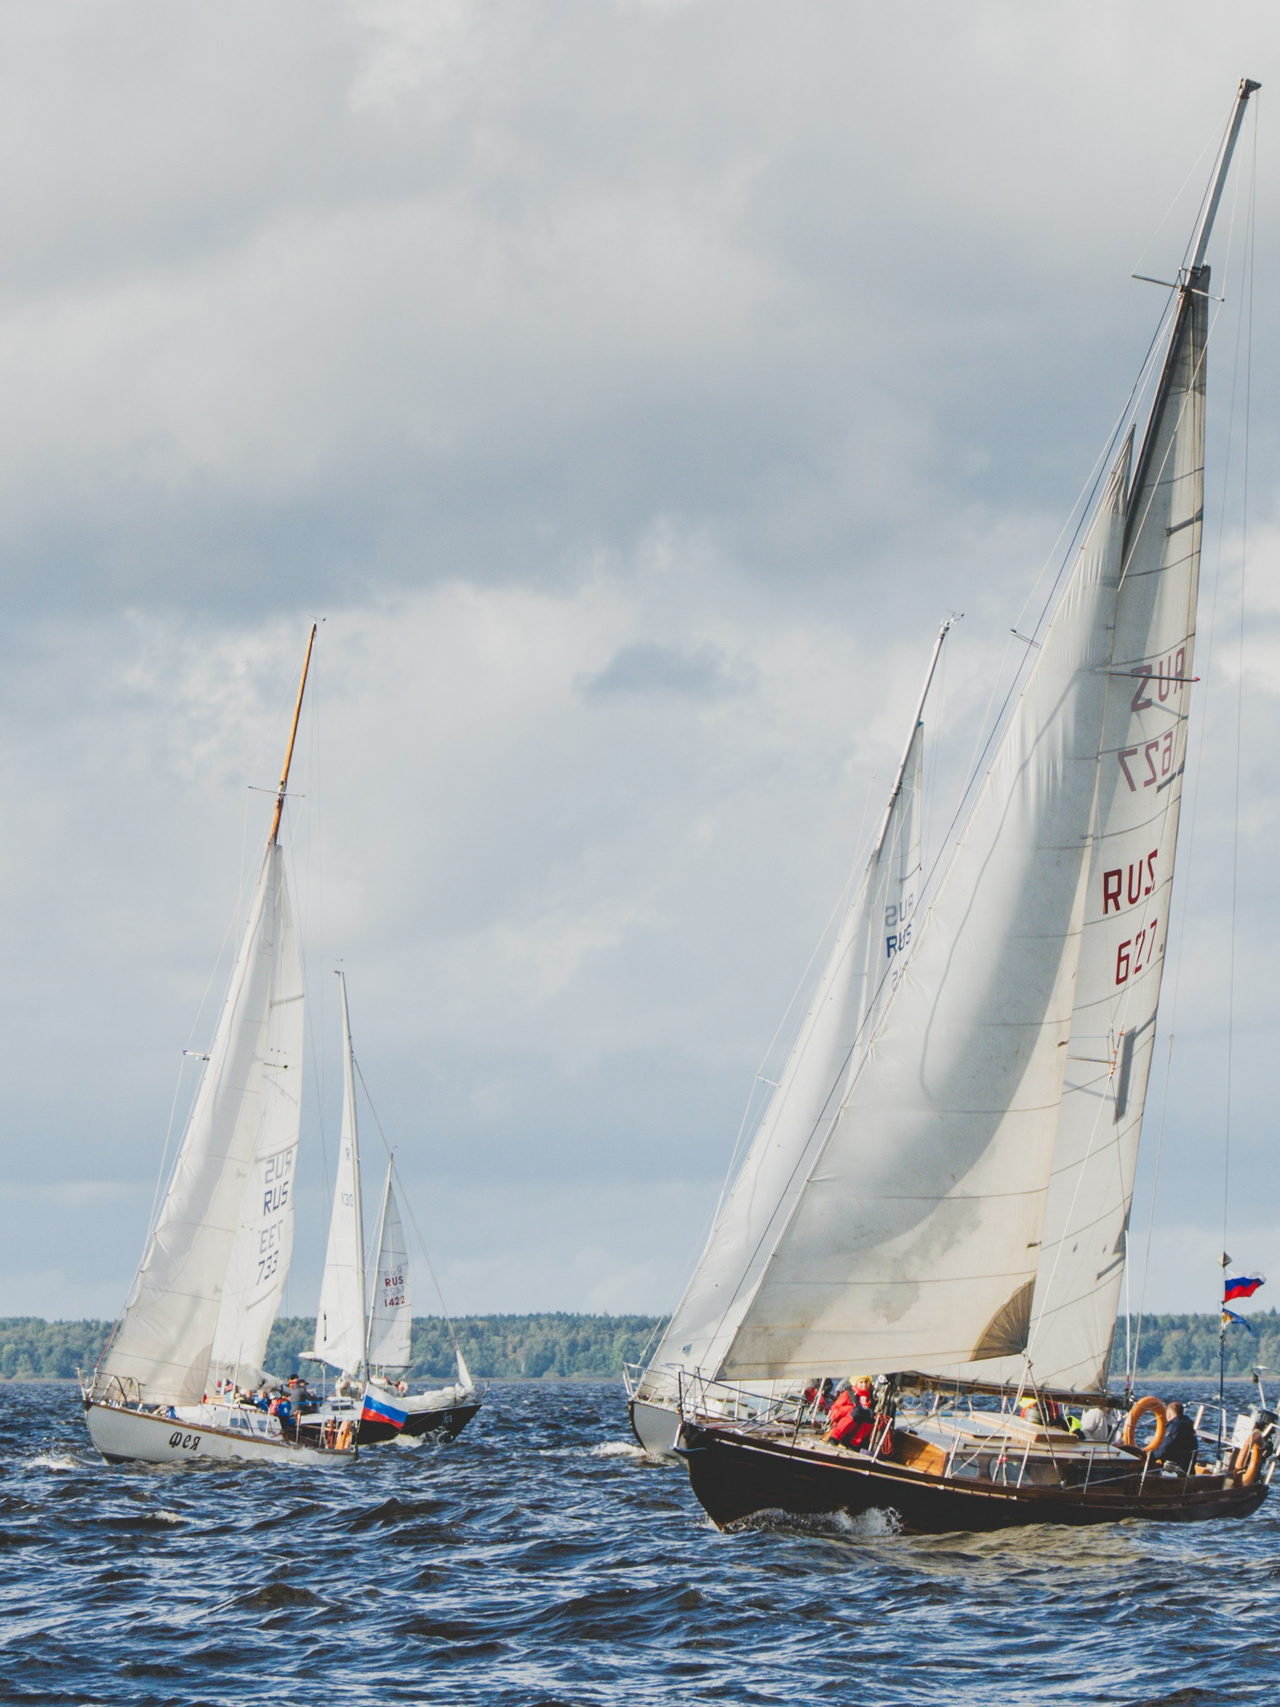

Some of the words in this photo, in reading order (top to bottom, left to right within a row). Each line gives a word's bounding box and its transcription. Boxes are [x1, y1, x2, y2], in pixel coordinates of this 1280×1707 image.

[1103, 848, 1158, 915] RUS
[1115, 918, 1158, 986] 627
[263, 1180, 289, 1216] RUS
[256, 1249, 280, 1286] 733
[385, 1275, 403, 1287] RUS
[384, 1295, 405, 1307] 1422
[169, 1431, 201, 1450] Фея
